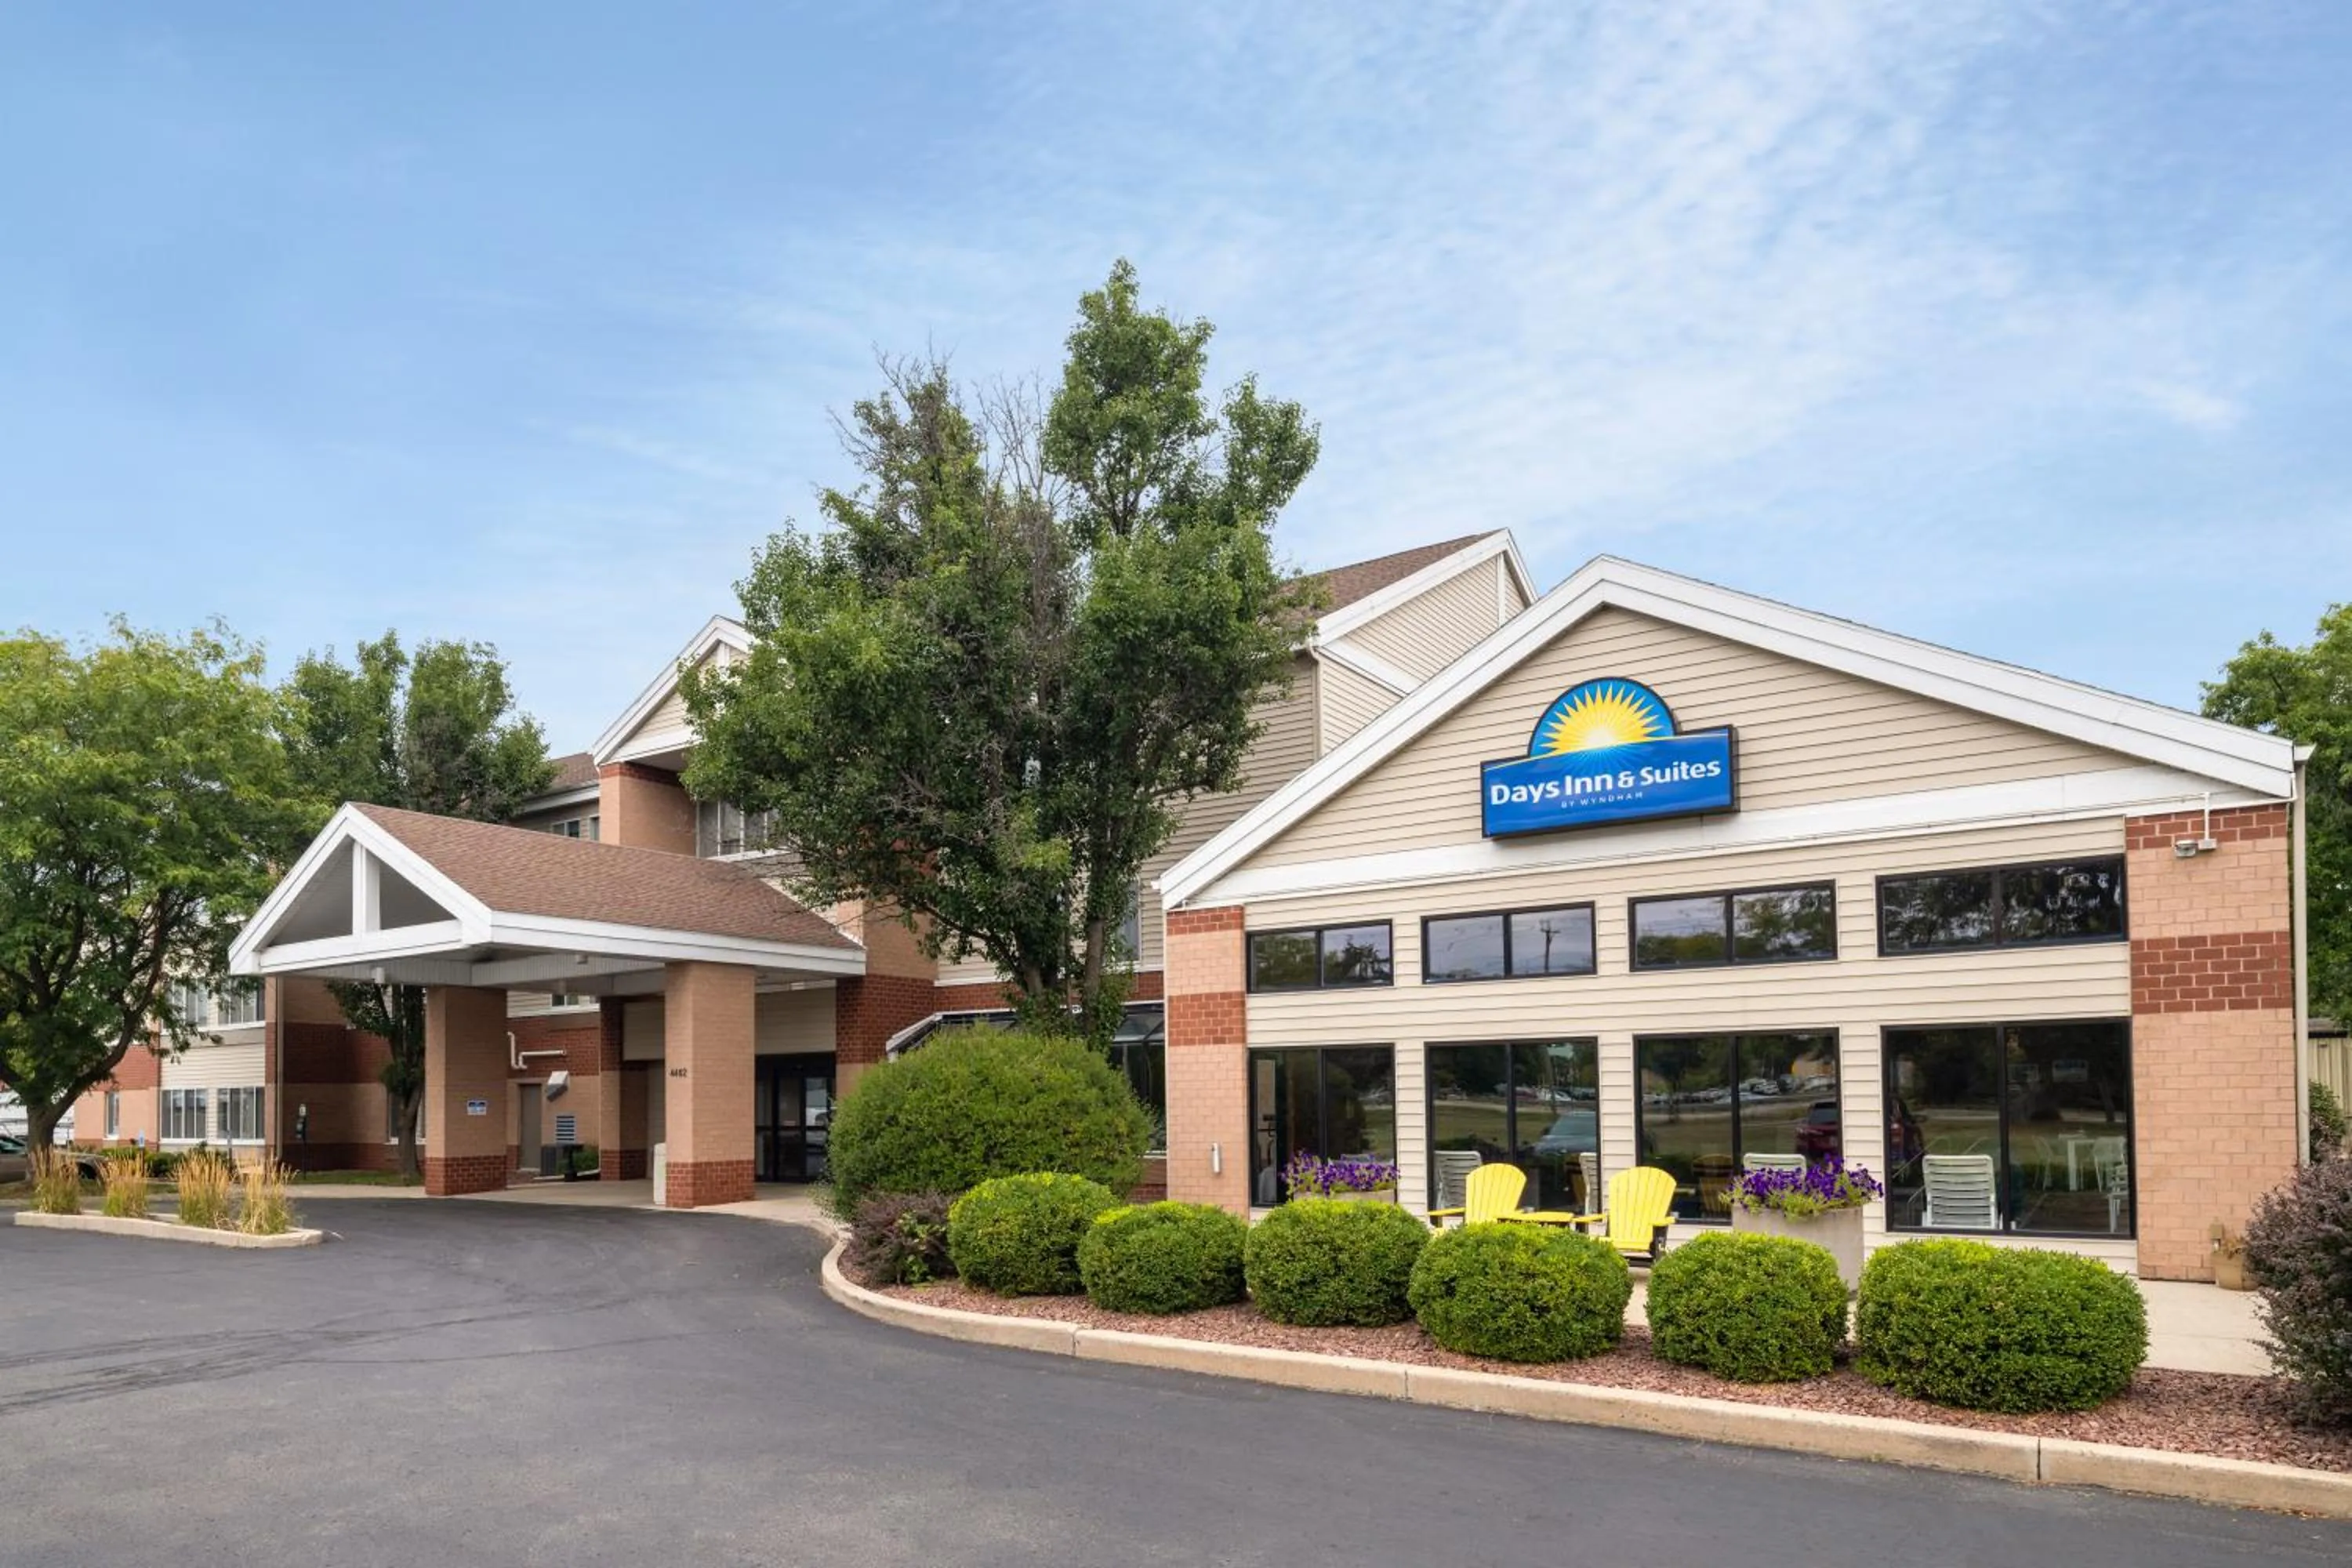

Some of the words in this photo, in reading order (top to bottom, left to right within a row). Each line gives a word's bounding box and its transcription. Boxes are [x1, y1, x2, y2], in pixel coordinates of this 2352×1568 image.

[1491, 781, 1559, 805] Days
[1565, 773, 1613, 796] Inn
[1617, 771, 1635, 788] &
[1639, 760, 1722, 786] Suites
[1561, 800, 1575, 809] BY
[1580, 791, 1643, 806] WYNDHAM
